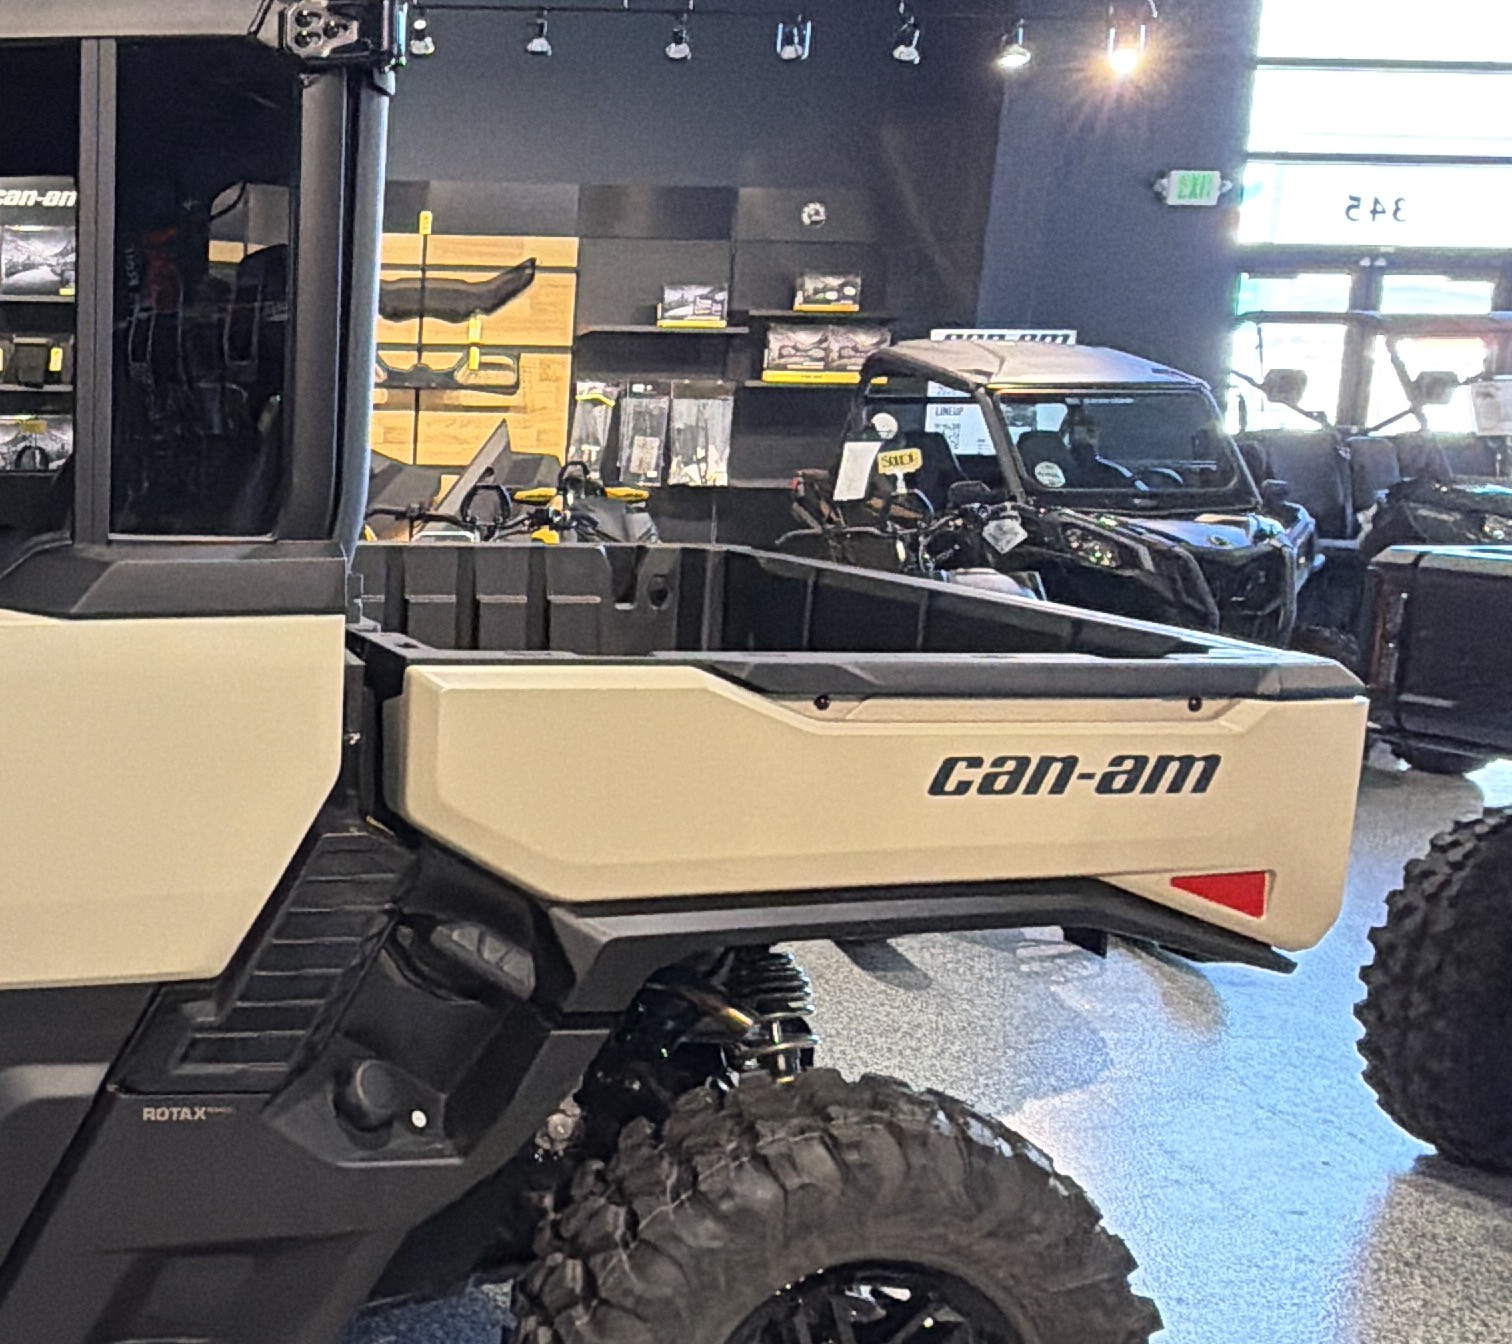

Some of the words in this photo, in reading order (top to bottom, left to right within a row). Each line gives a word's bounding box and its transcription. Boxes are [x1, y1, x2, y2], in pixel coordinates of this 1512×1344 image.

[1177, 173, 1212, 200] EXIT
[934, 406, 964, 417] LINEUP
[927, 753, 1222, 796] can-am
[142, 1106, 207, 1122] ROTAX
